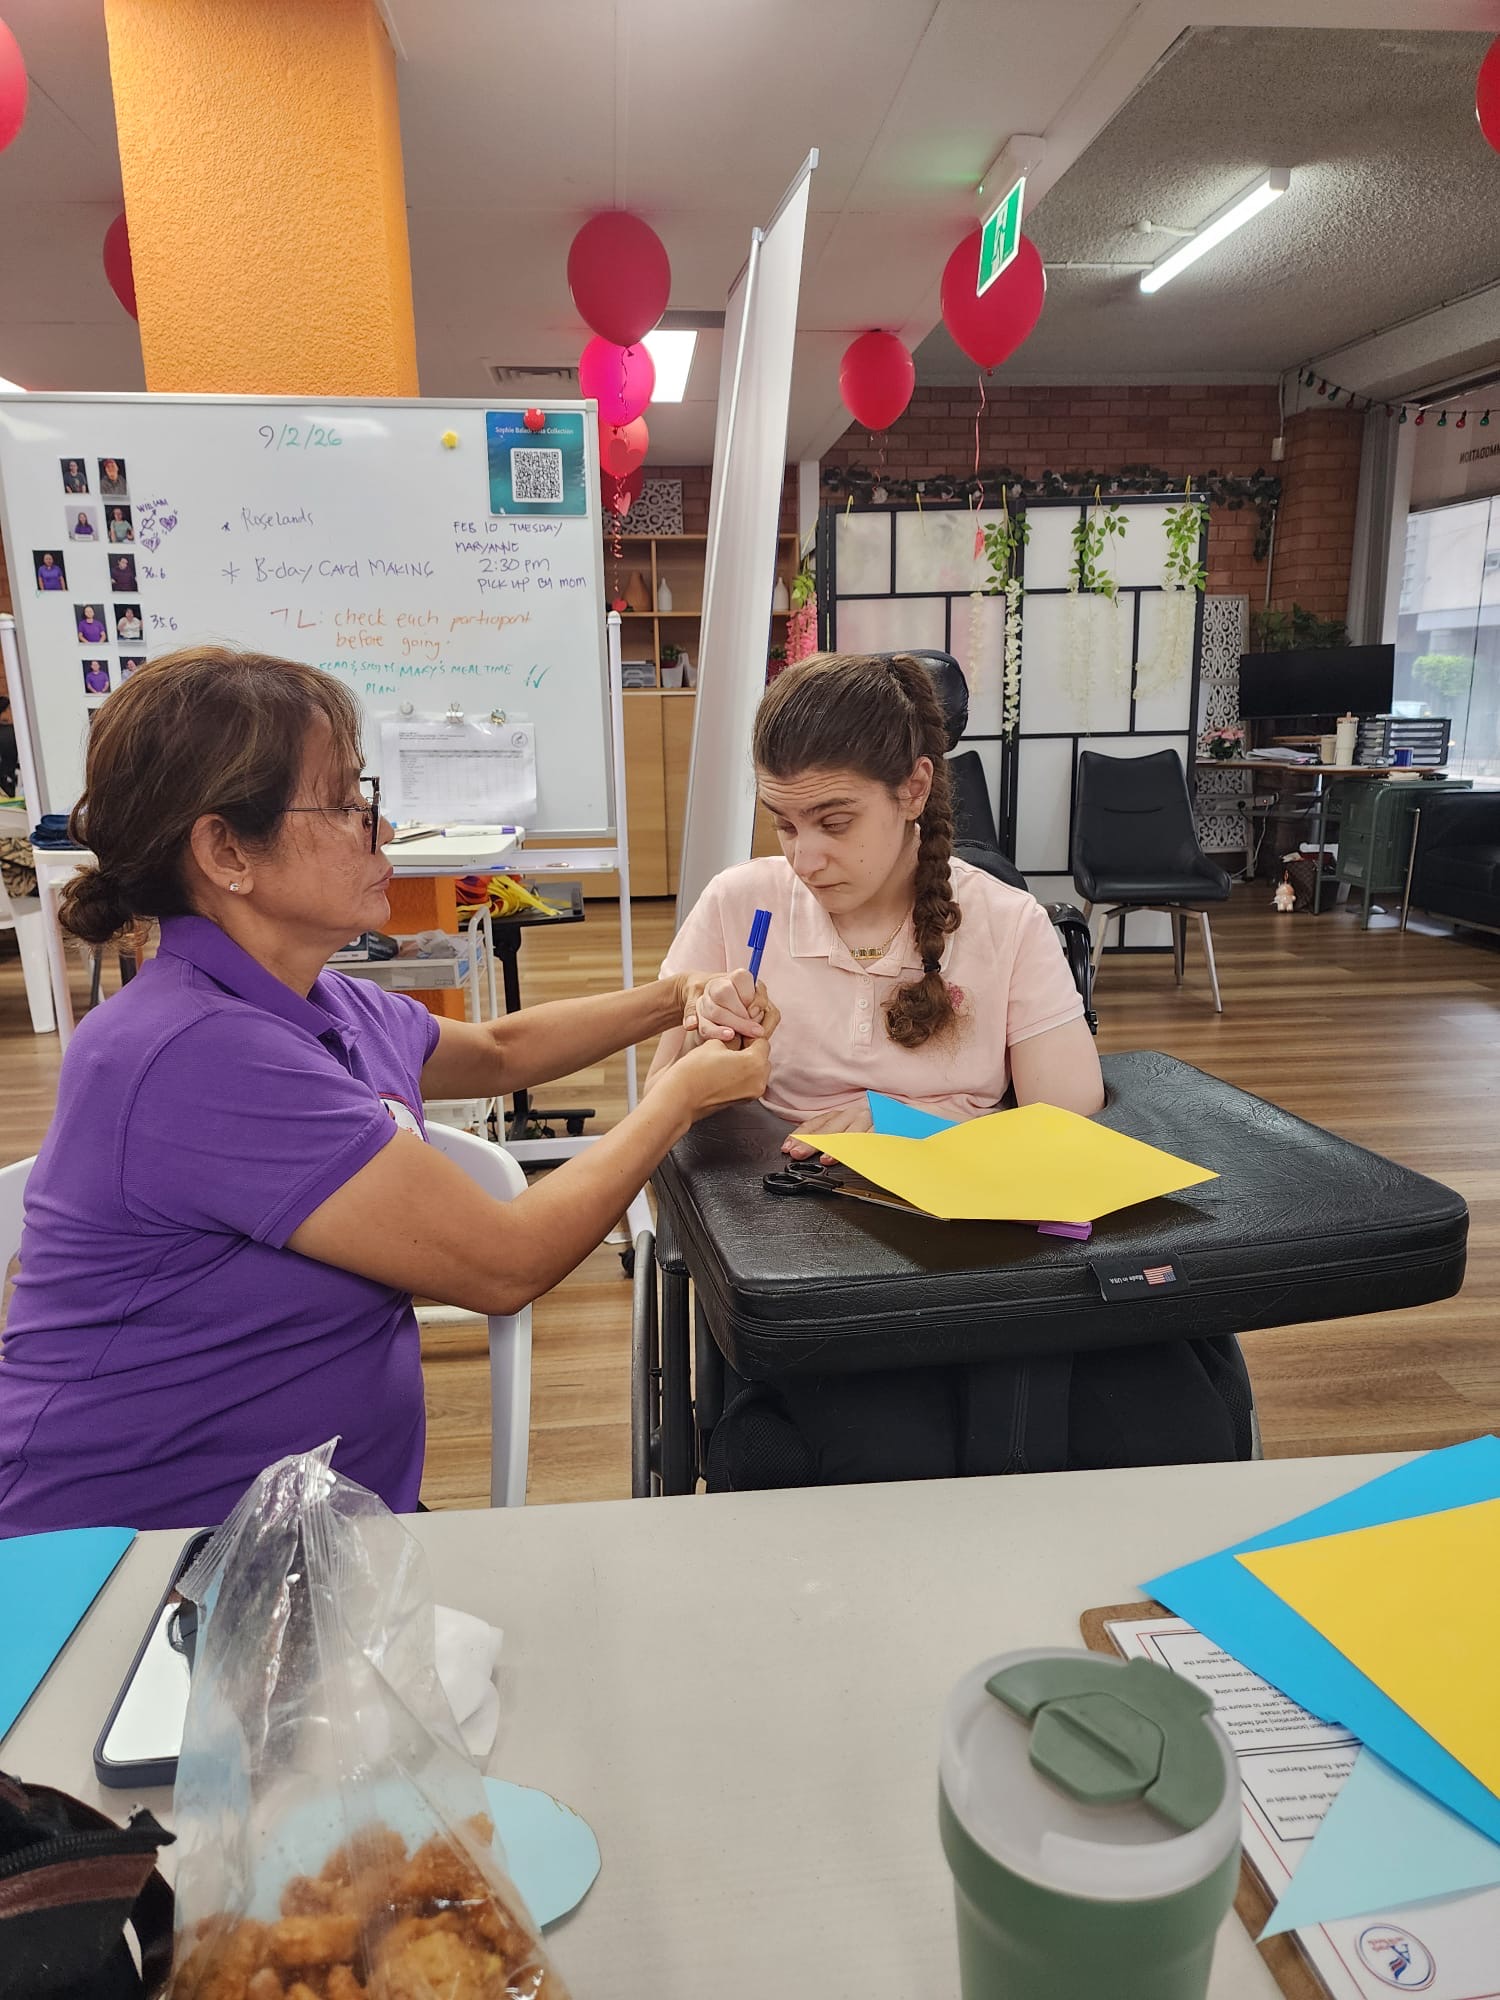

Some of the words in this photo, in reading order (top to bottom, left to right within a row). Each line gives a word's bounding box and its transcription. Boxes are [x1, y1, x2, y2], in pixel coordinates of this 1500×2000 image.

[258, 423, 343, 450] 9/2/26
[453, 521, 477, 534] FEB
[484, 521, 498, 533] 10
[509, 522, 563, 536] TUESDAY
[479, 557, 520, 573] 2:30
[150, 614, 178, 631] 35.6
[335, 607, 388, 626] check
[396, 609, 439, 628] each
[336, 629, 384, 650] before
